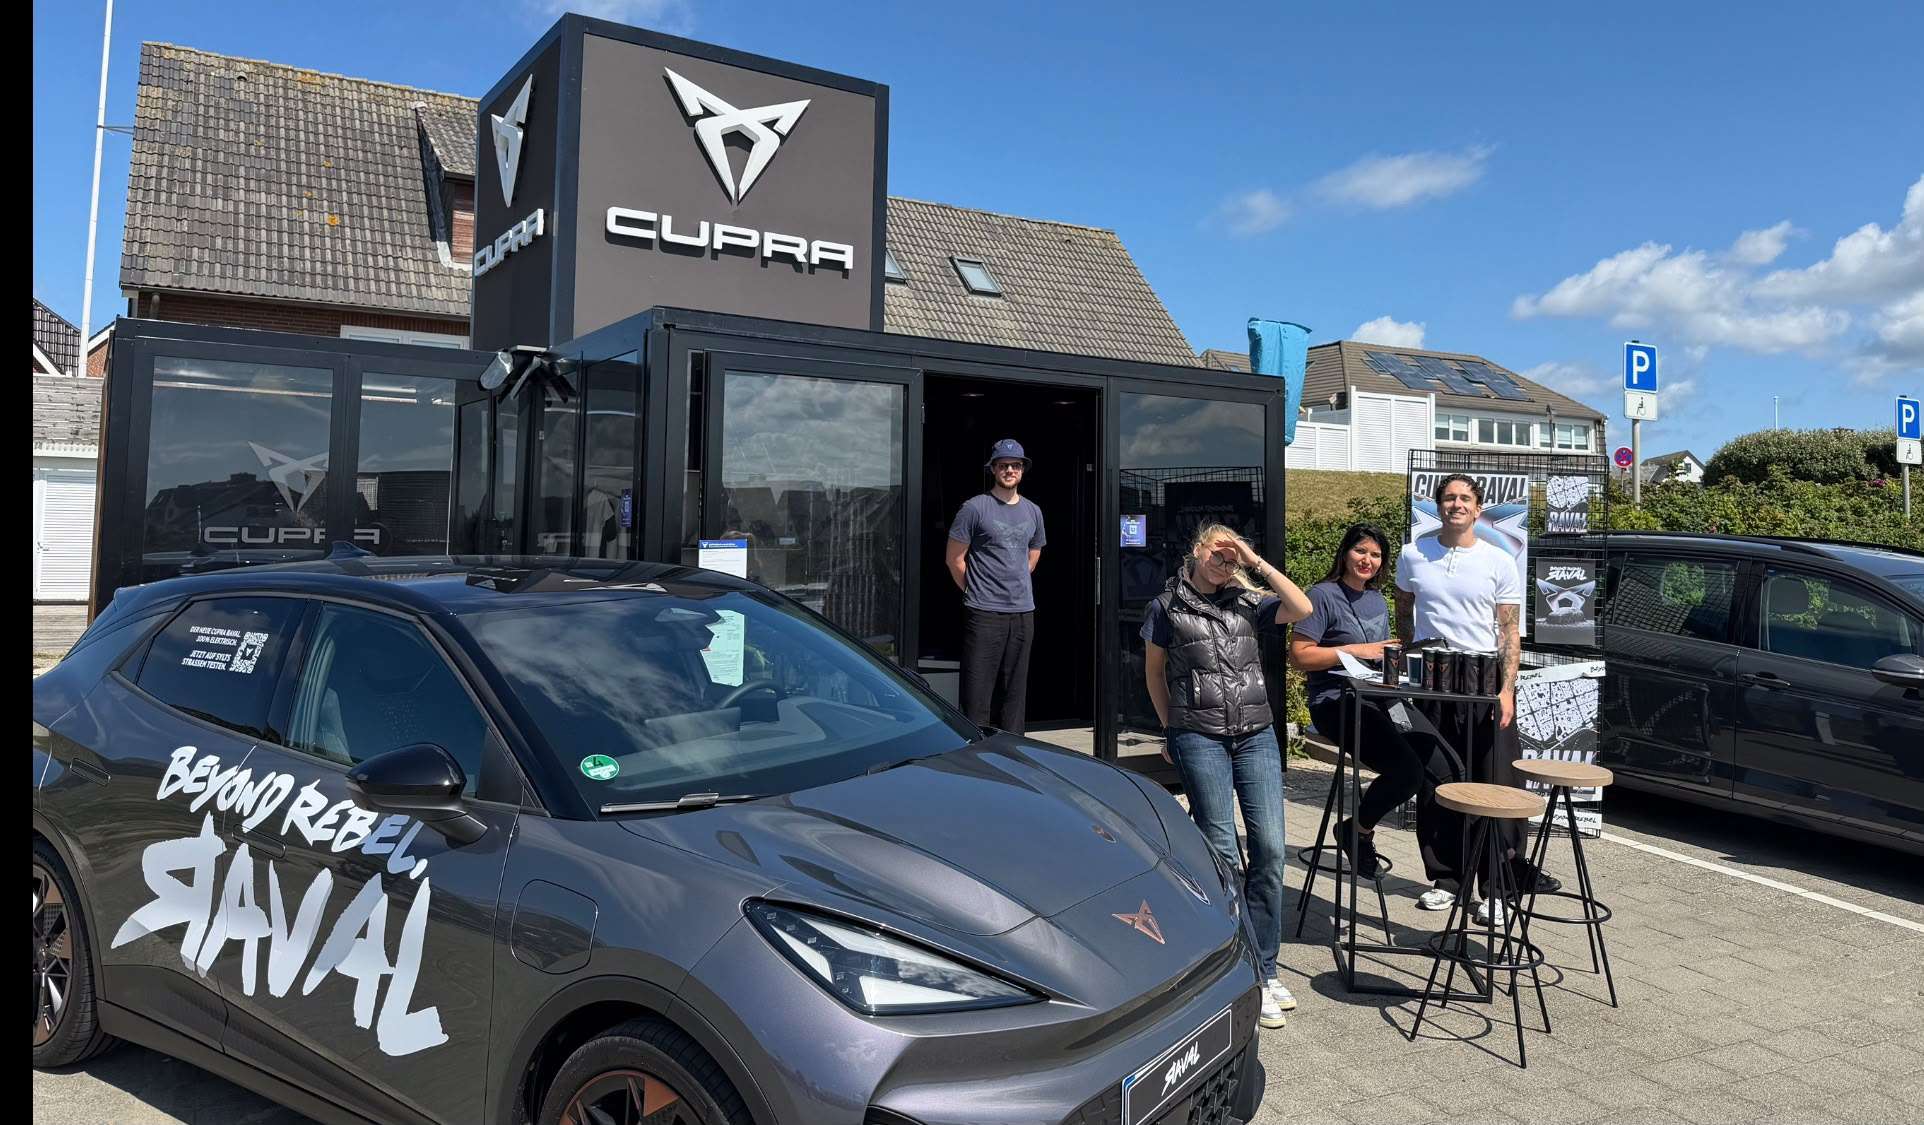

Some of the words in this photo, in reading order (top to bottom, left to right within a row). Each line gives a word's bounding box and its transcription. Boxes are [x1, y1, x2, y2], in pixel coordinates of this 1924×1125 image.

[474, 208, 545, 276] CUPRA
[606, 206, 854, 269] CUPRA
[1632, 349, 1650, 384] P
[1902, 403, 1916, 434] P
[211, 628, 227, 636] CUPRA
[181, 658, 207, 668] STRASSEN
[190, 650, 207, 658] JETZT
[205, 651, 216, 660] AUF
[216, 653, 232, 662] SYLTS
[157, 745, 295, 834] BEYOND
